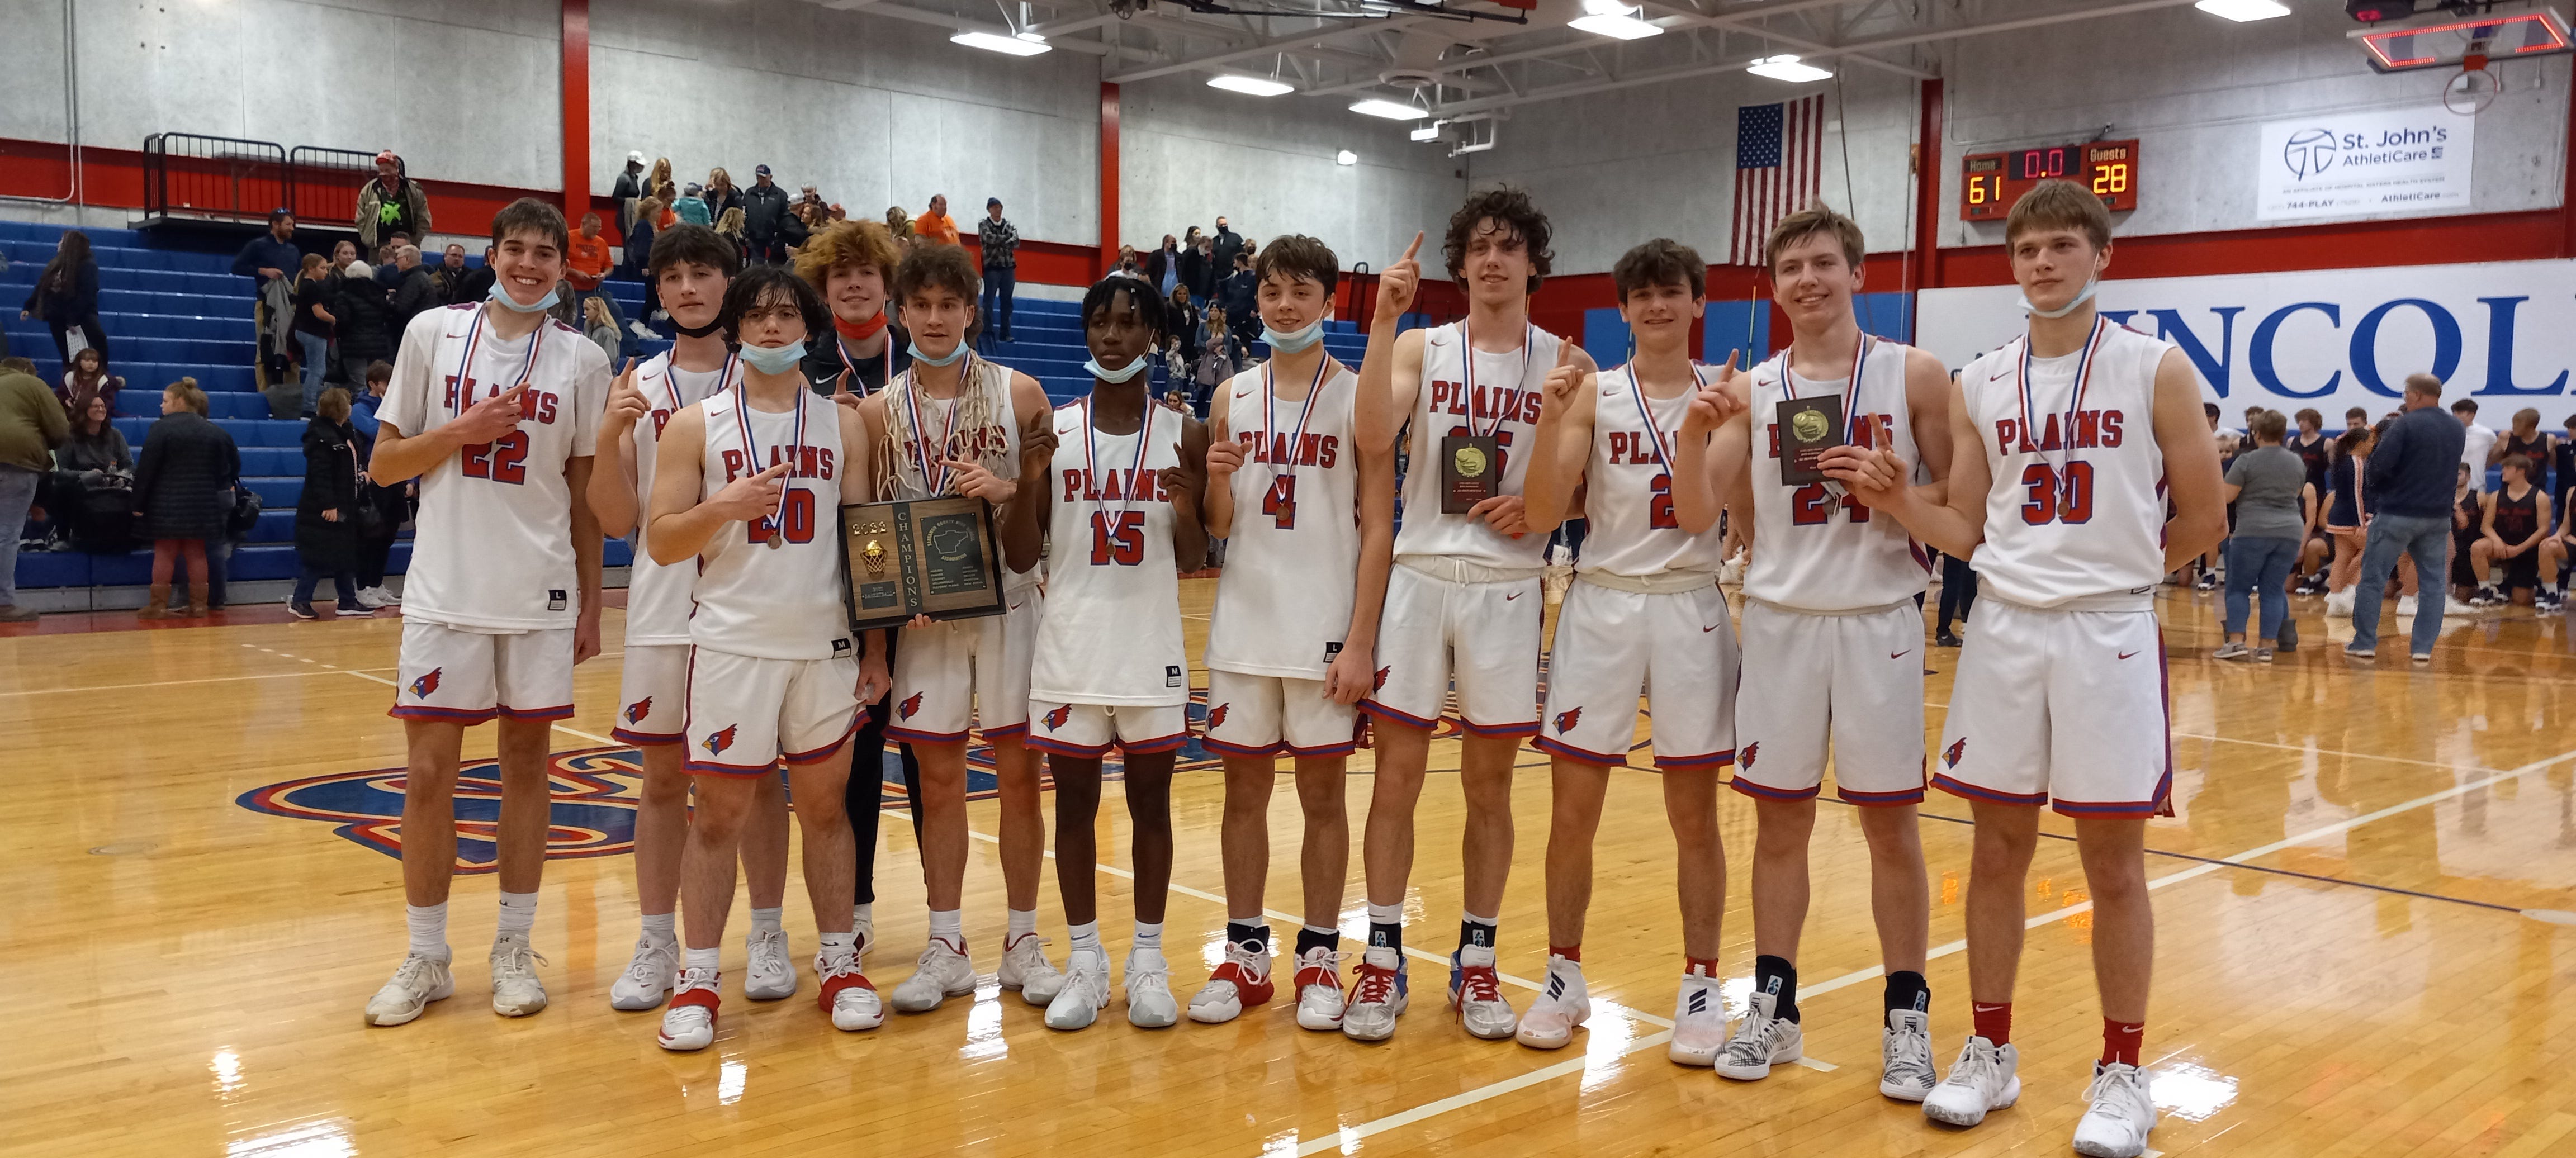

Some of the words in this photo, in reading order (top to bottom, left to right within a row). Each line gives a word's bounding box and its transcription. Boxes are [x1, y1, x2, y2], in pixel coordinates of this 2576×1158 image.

[2343, 133, 2369, 150] St.
[2376, 126, 2447, 147] John's
[1969, 159, 1996, 172] Home
[2024, 148, 2064, 178] 0.0
[2090, 147, 2127, 162] Guests
[2343, 148, 2427, 167] AthletiCare
[1969, 176, 2001, 204] 61
[2093, 164, 2127, 194] 28
[1429, 380, 1542, 425] PLAINS
[1996, 410, 2124, 456] PLAINS
[462, 430, 529, 485] 22
[1062, 468, 1172, 502] PLAINS
[2021, 460, 2094, 526] 30
[1262, 474, 1296, 530] 4
[852, 521, 888, 535] 2022
[1090, 510, 1145, 566] 15
[897, 511, 917, 608] CHAMPIONS
